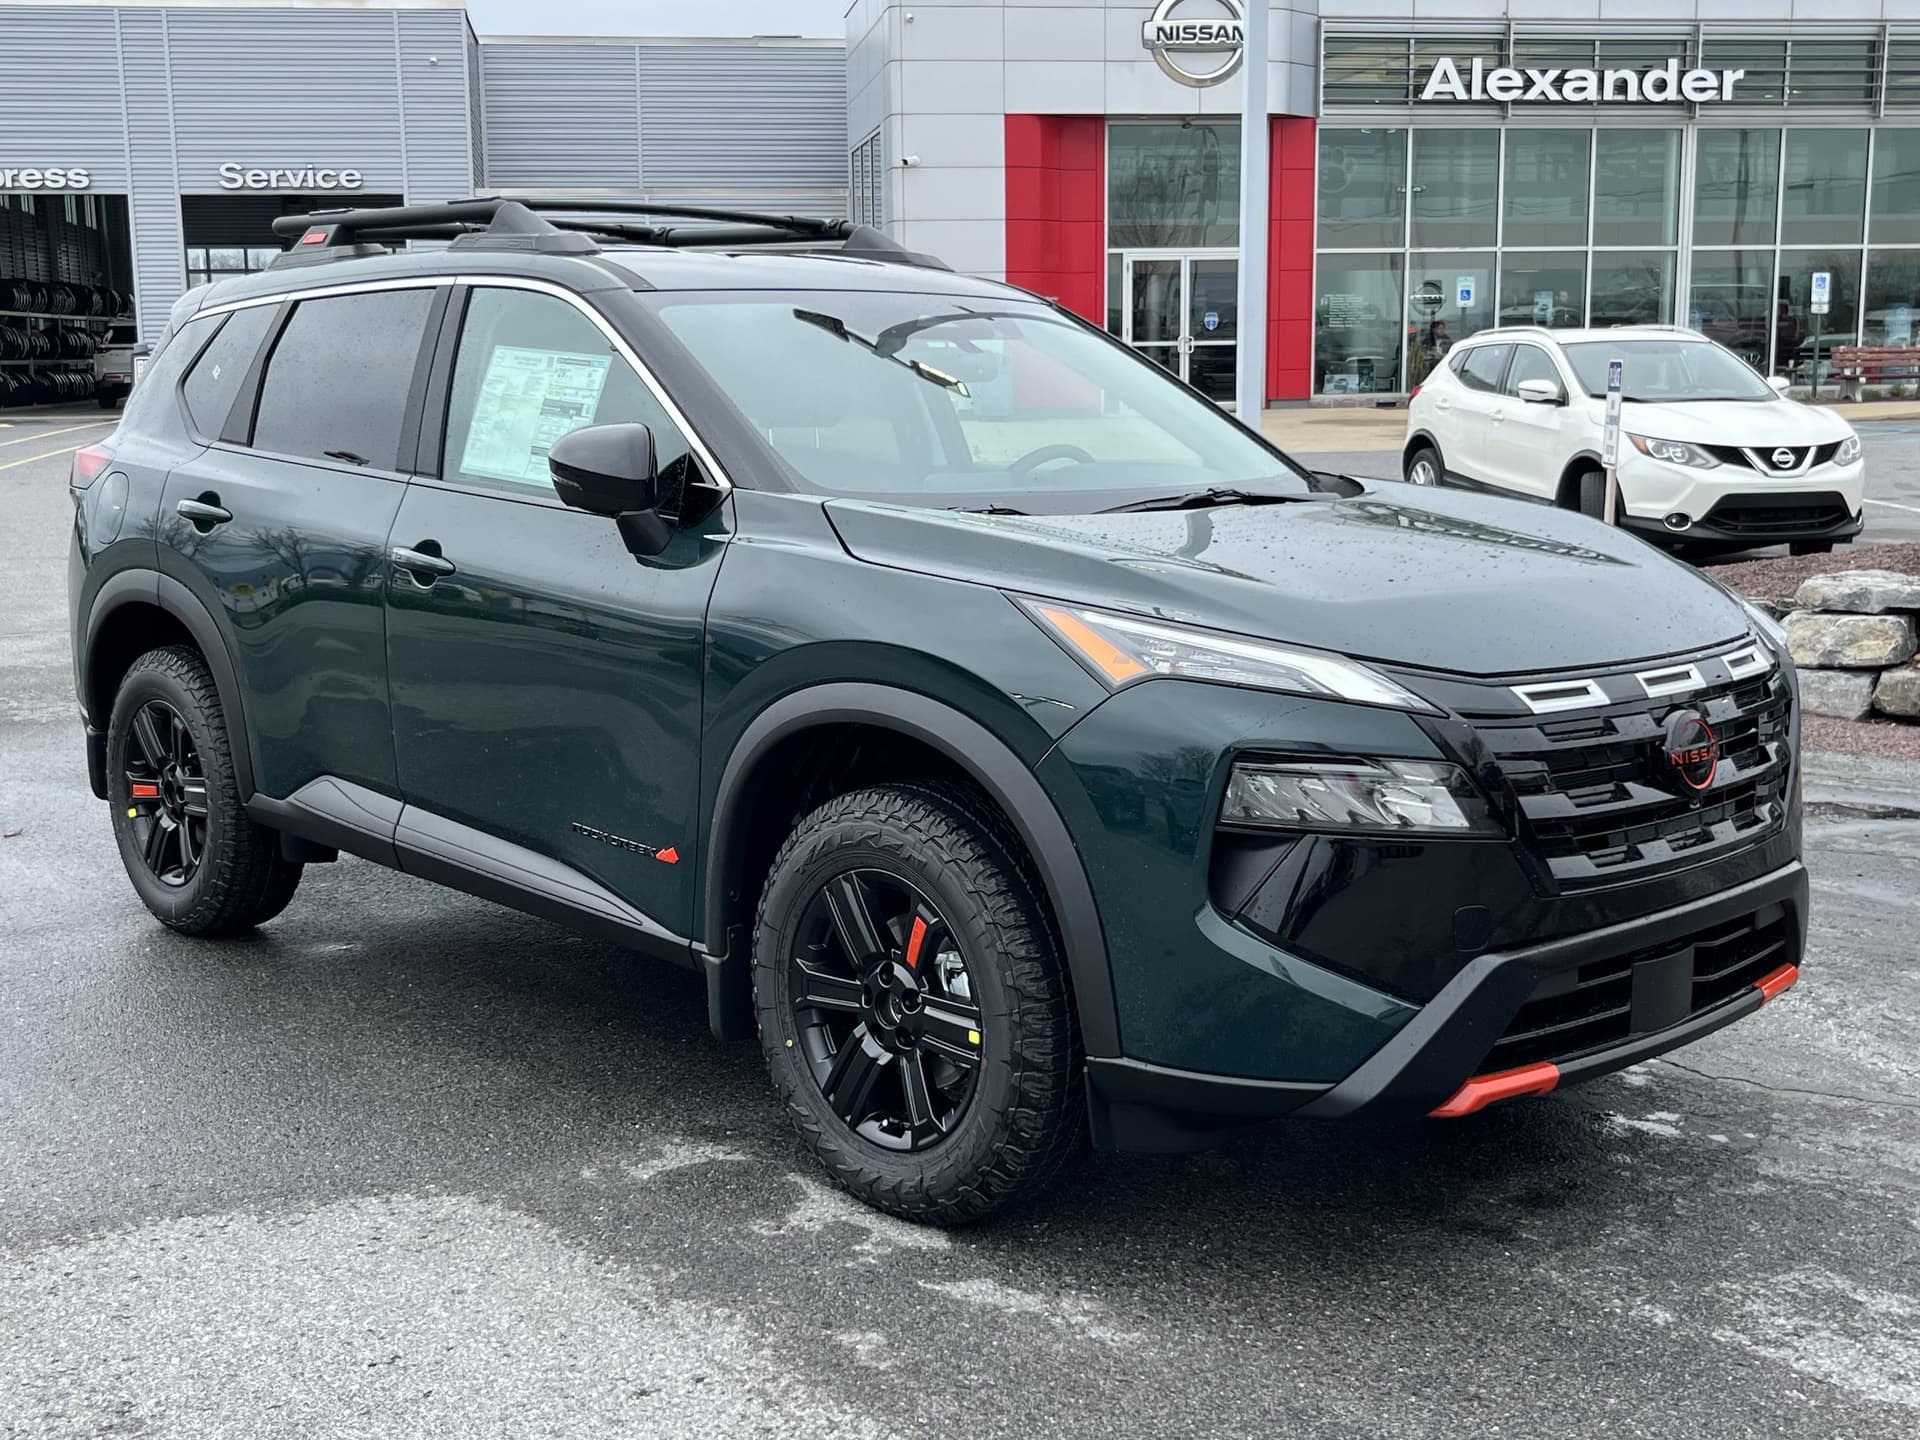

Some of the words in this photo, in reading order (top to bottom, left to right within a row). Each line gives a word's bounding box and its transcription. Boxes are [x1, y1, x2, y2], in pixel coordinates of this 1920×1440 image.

[1156, 24, 1244, 42] NISSAN
[1420, 57, 1745, 102] Alexander
[219, 162, 363, 189] Service
